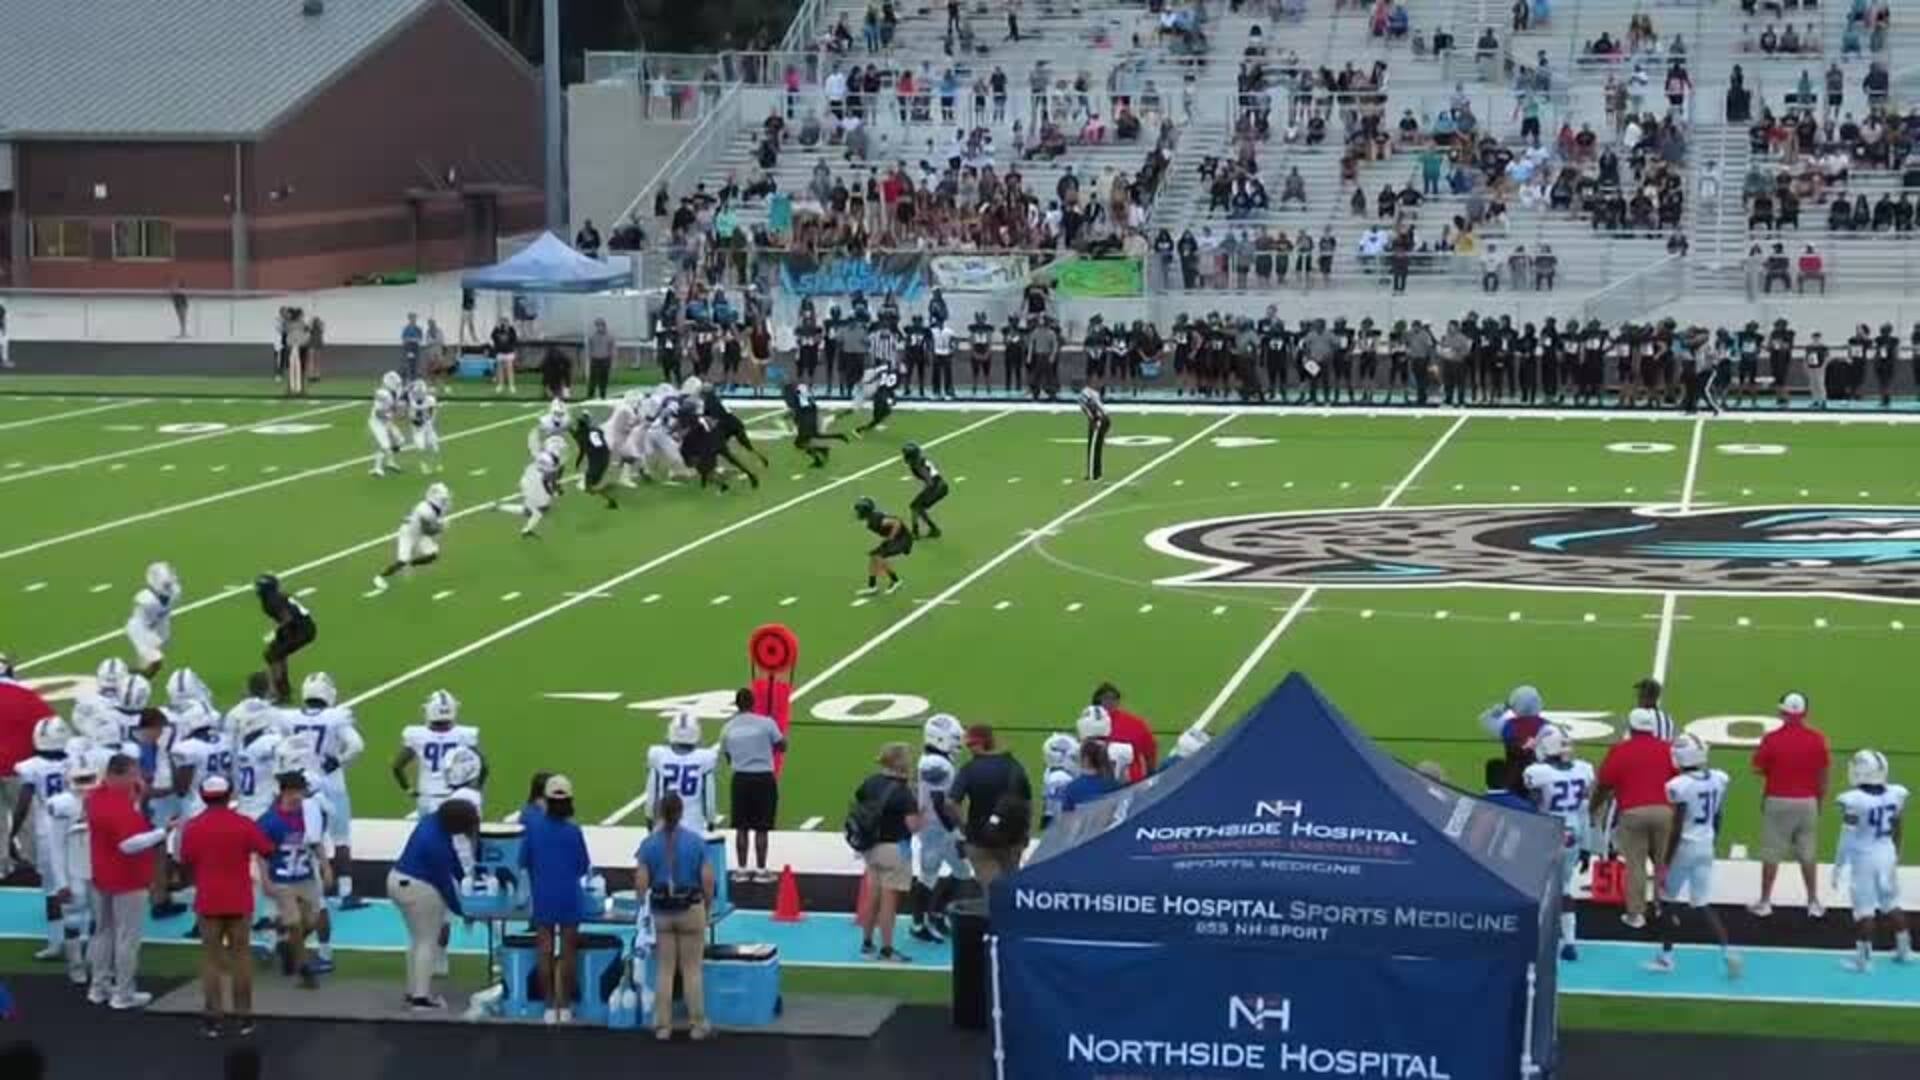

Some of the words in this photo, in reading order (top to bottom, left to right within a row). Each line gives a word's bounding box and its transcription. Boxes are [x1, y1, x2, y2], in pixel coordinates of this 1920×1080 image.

[663, 764, 700, 797] 26
[1550, 780, 1584, 811] 23
[1255, 800, 1301, 817] NH
[1135, 821, 1281, 840] NORTHSIDE
[1292, 822, 1417, 844] HOSPITAL
[1173, 859, 1255, 871] SPORTS
[1260, 859, 1361, 875] MEDICINE
[1015, 889, 1157, 913] NORTHSIDE
[1163, 895, 1283, 919] HOSPITAL
[1290, 901, 1388, 926] SPORTS
[1395, 907, 1518, 932] MEDICINE
[1229, 996, 1290, 1032] NH
[1067, 1033, 1265, 1069] NORTHSIDE
[1280, 1043, 1451, 1080] HOSPITAL
